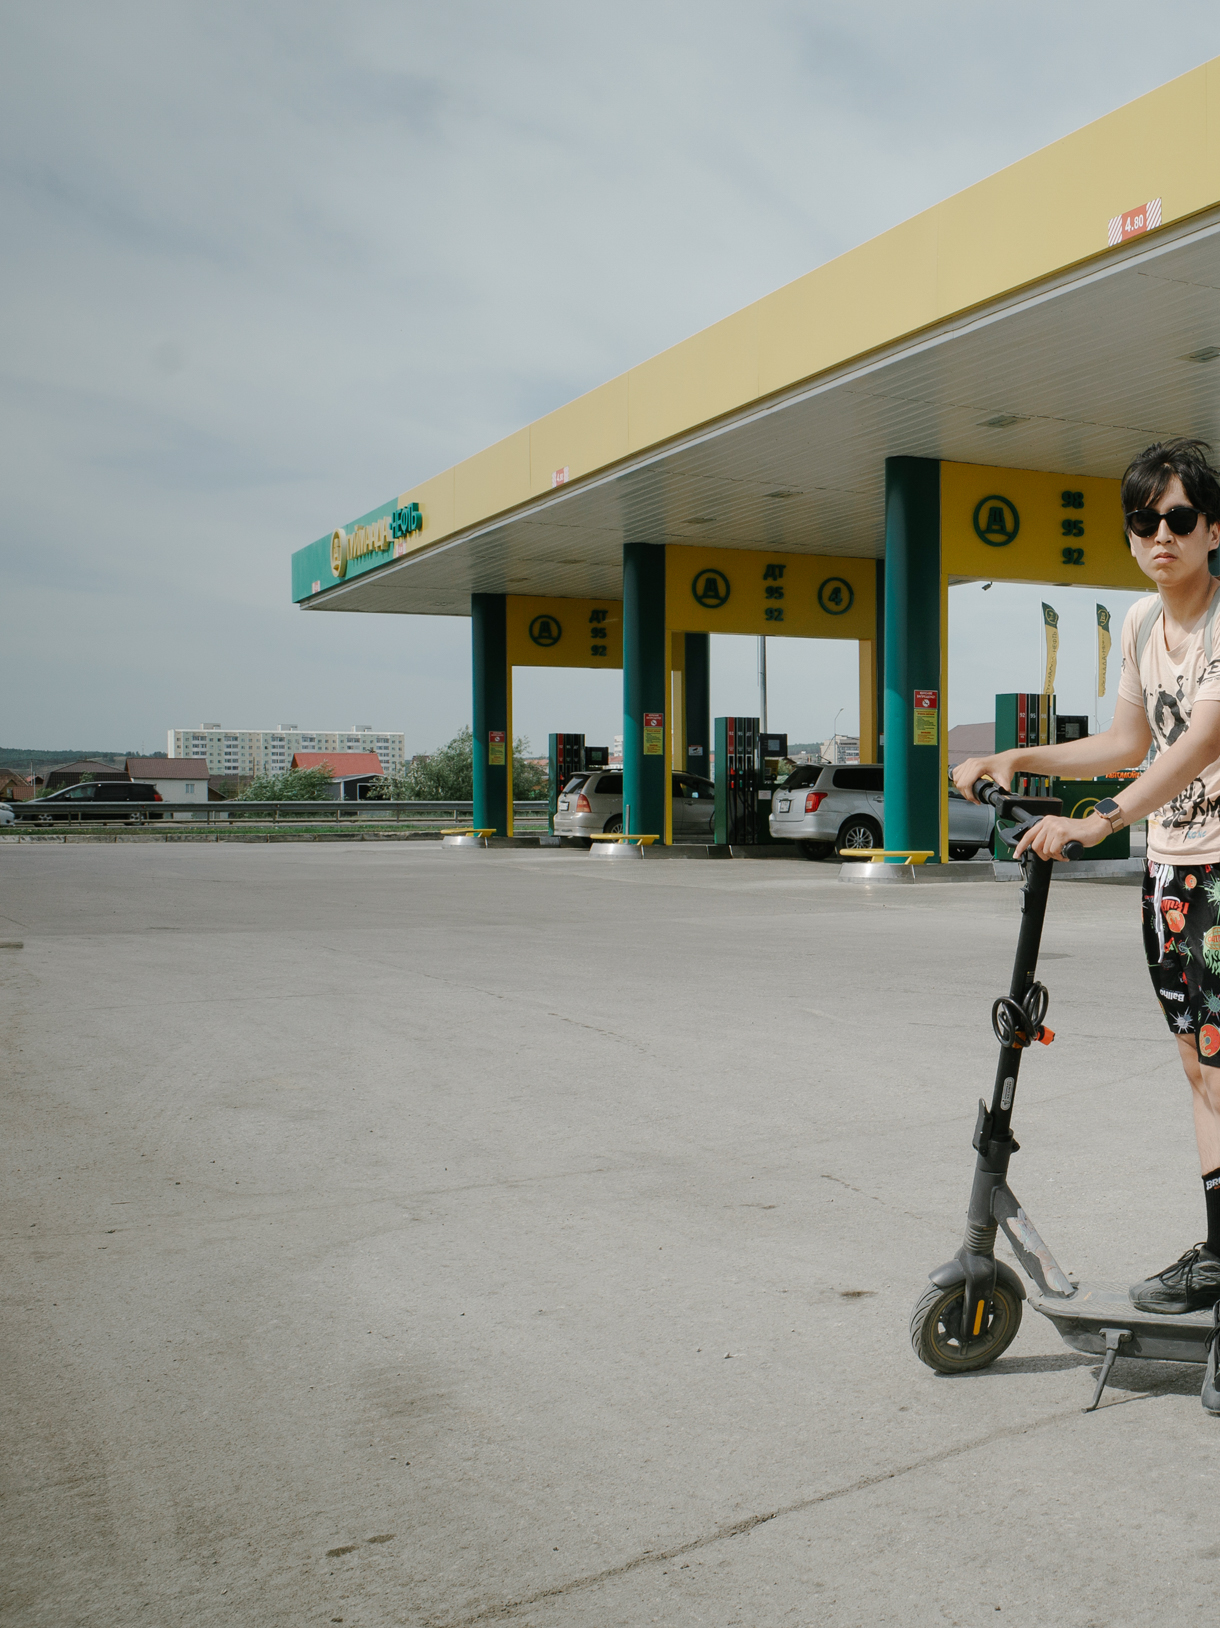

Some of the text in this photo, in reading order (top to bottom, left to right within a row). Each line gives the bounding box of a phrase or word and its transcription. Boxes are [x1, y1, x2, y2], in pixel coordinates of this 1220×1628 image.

[1124, 214, 1144, 232] 4.80
[1061, 490, 1084, 509] 98
[1061, 519, 1085, 537] 95
[1062, 547, 1085, 566] 92
[763, 564, 786, 581] ДТ
[765, 586, 784, 600] 95
[828, 586, 843, 606] 4
[765, 607, 784, 622] 92
[590, 627, 607, 639] 95
[590, 645, 607, 657] 92
